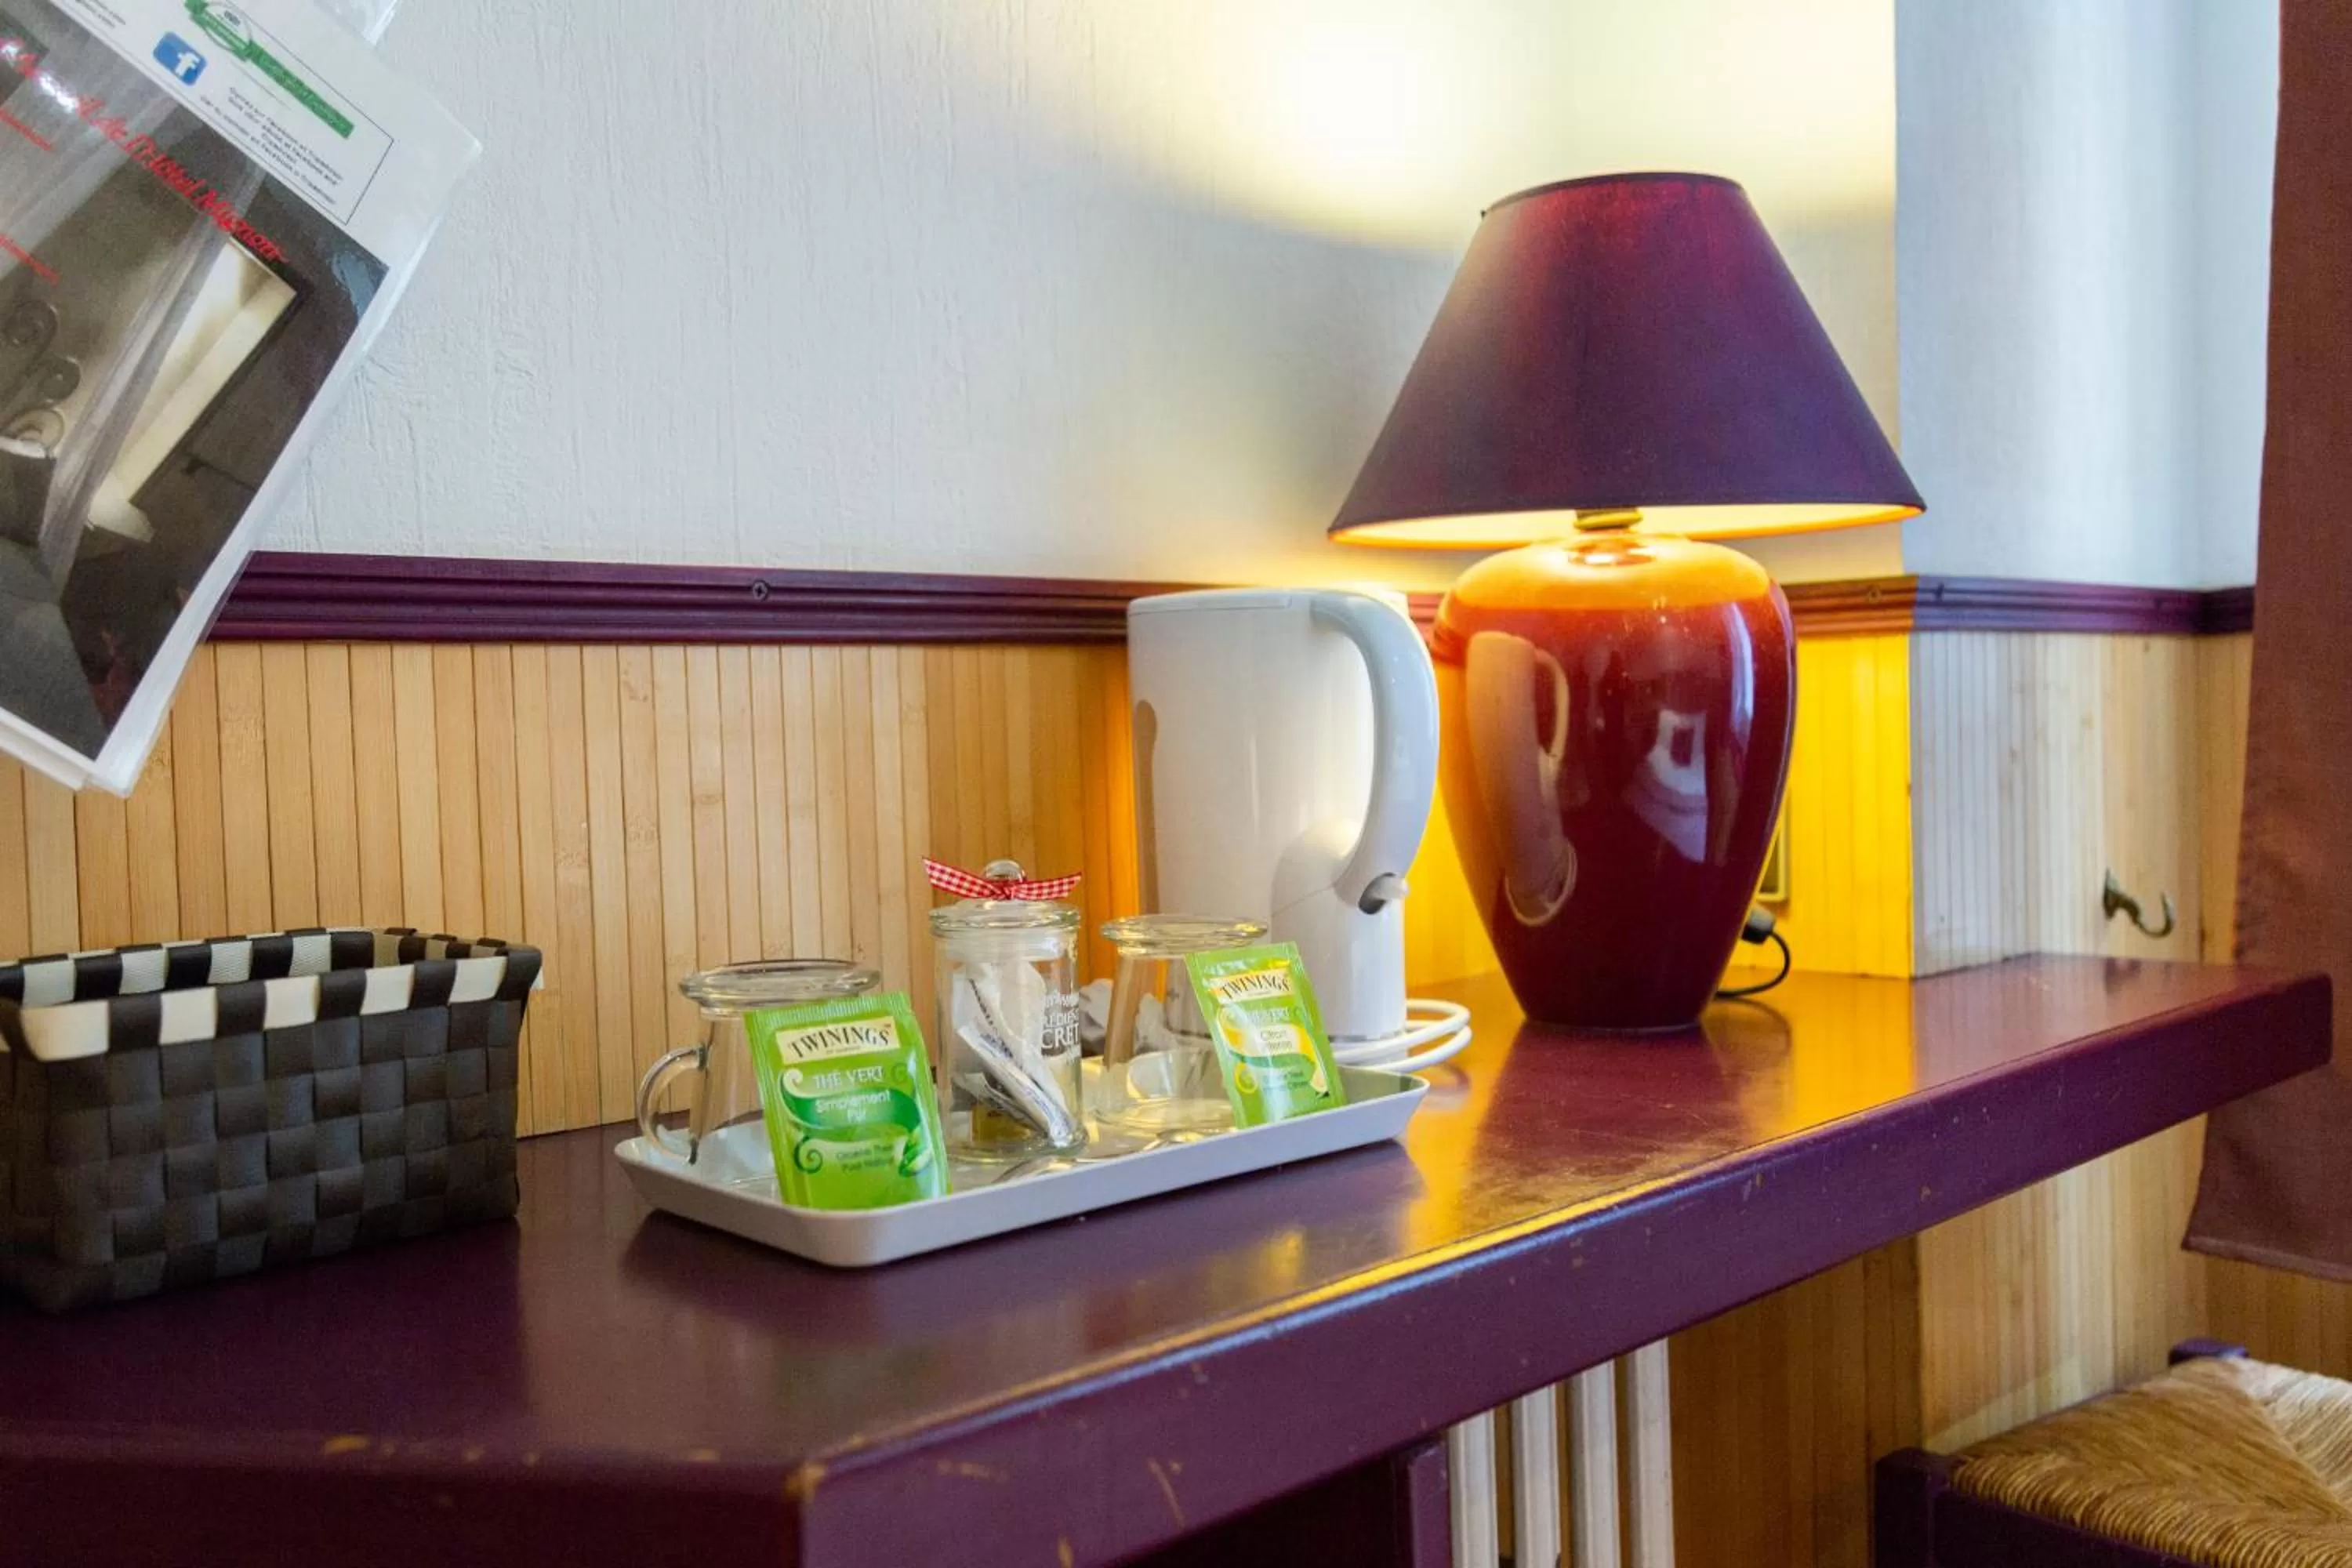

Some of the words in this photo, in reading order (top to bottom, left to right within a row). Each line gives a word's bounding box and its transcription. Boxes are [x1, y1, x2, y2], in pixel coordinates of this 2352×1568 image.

[1219, 975, 1290, 1000] TWININGS
[786, 1026, 890, 1058] TWININGS
[846, 1065, 883, 1084] VERT
